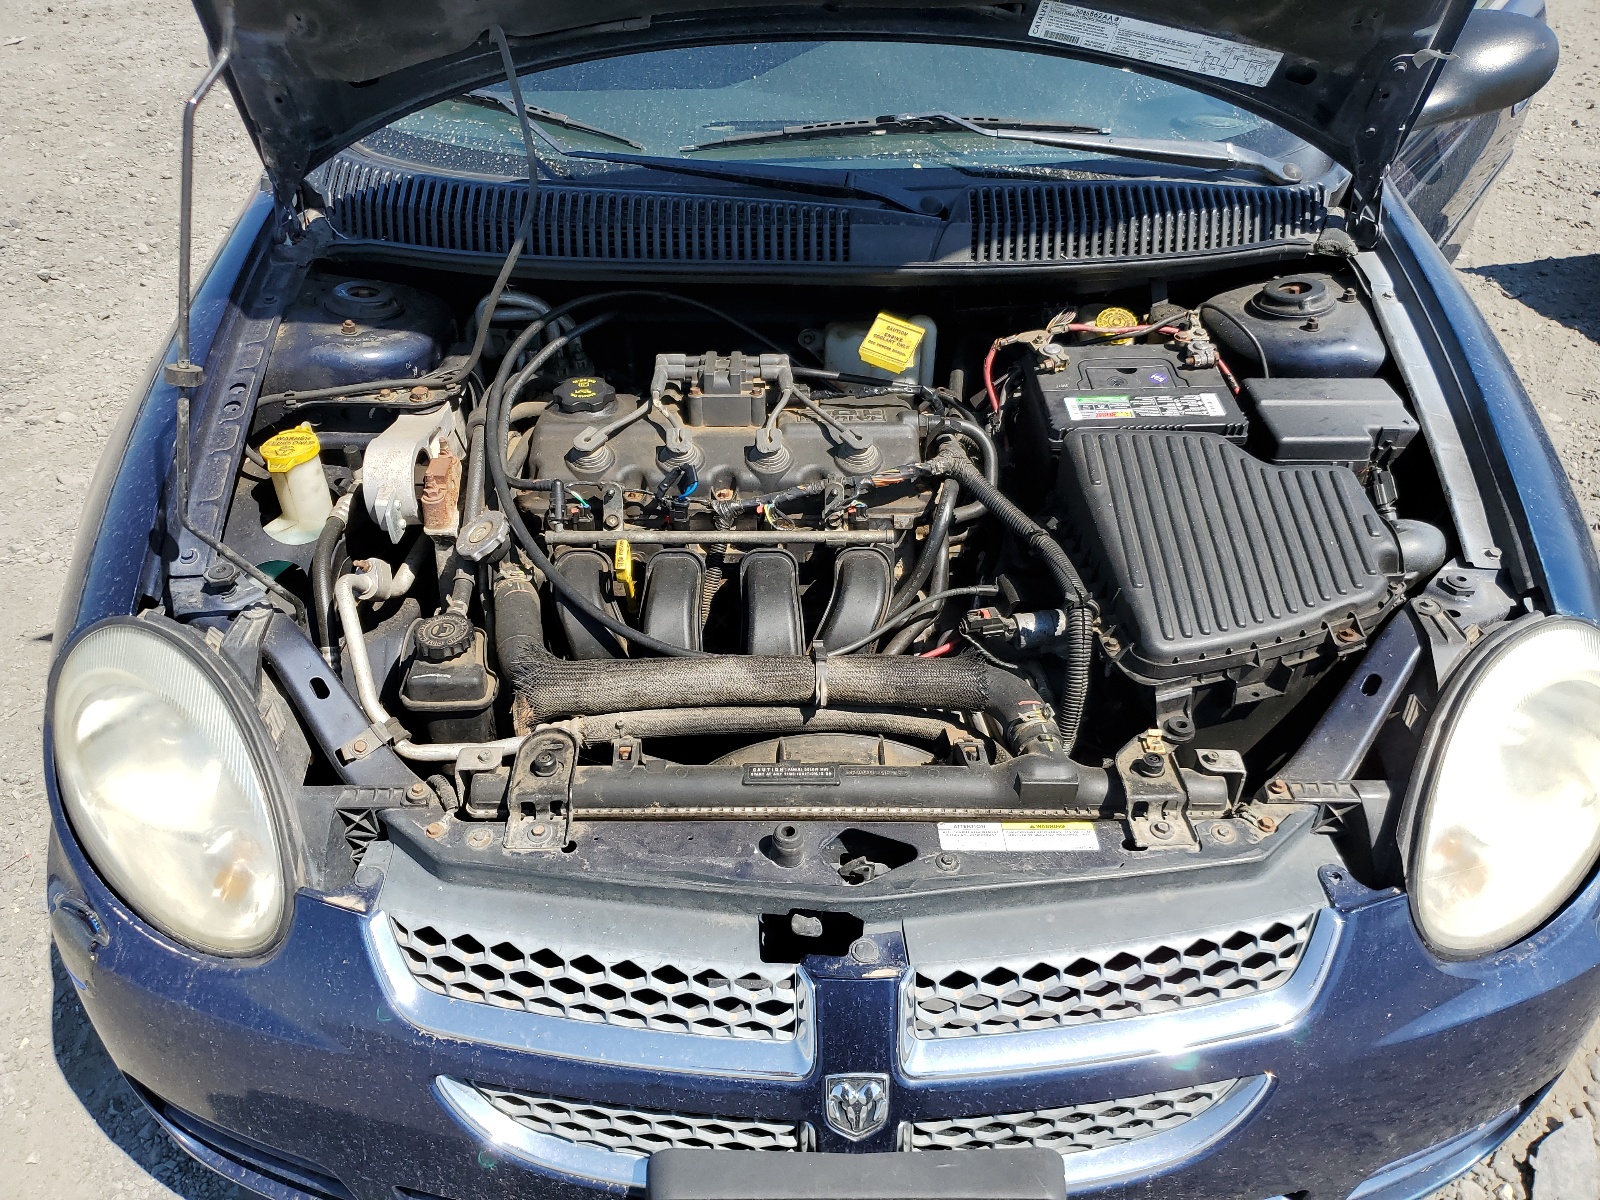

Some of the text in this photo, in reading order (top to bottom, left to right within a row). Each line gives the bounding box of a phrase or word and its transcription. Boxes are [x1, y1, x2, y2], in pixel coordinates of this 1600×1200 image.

[1033, 1, 1049, 34] CATALYST
[886, 325, 909, 336] CAUTION
[873, 333, 895, 345] COOLANT
[884, 332, 904, 343] ENGINE
